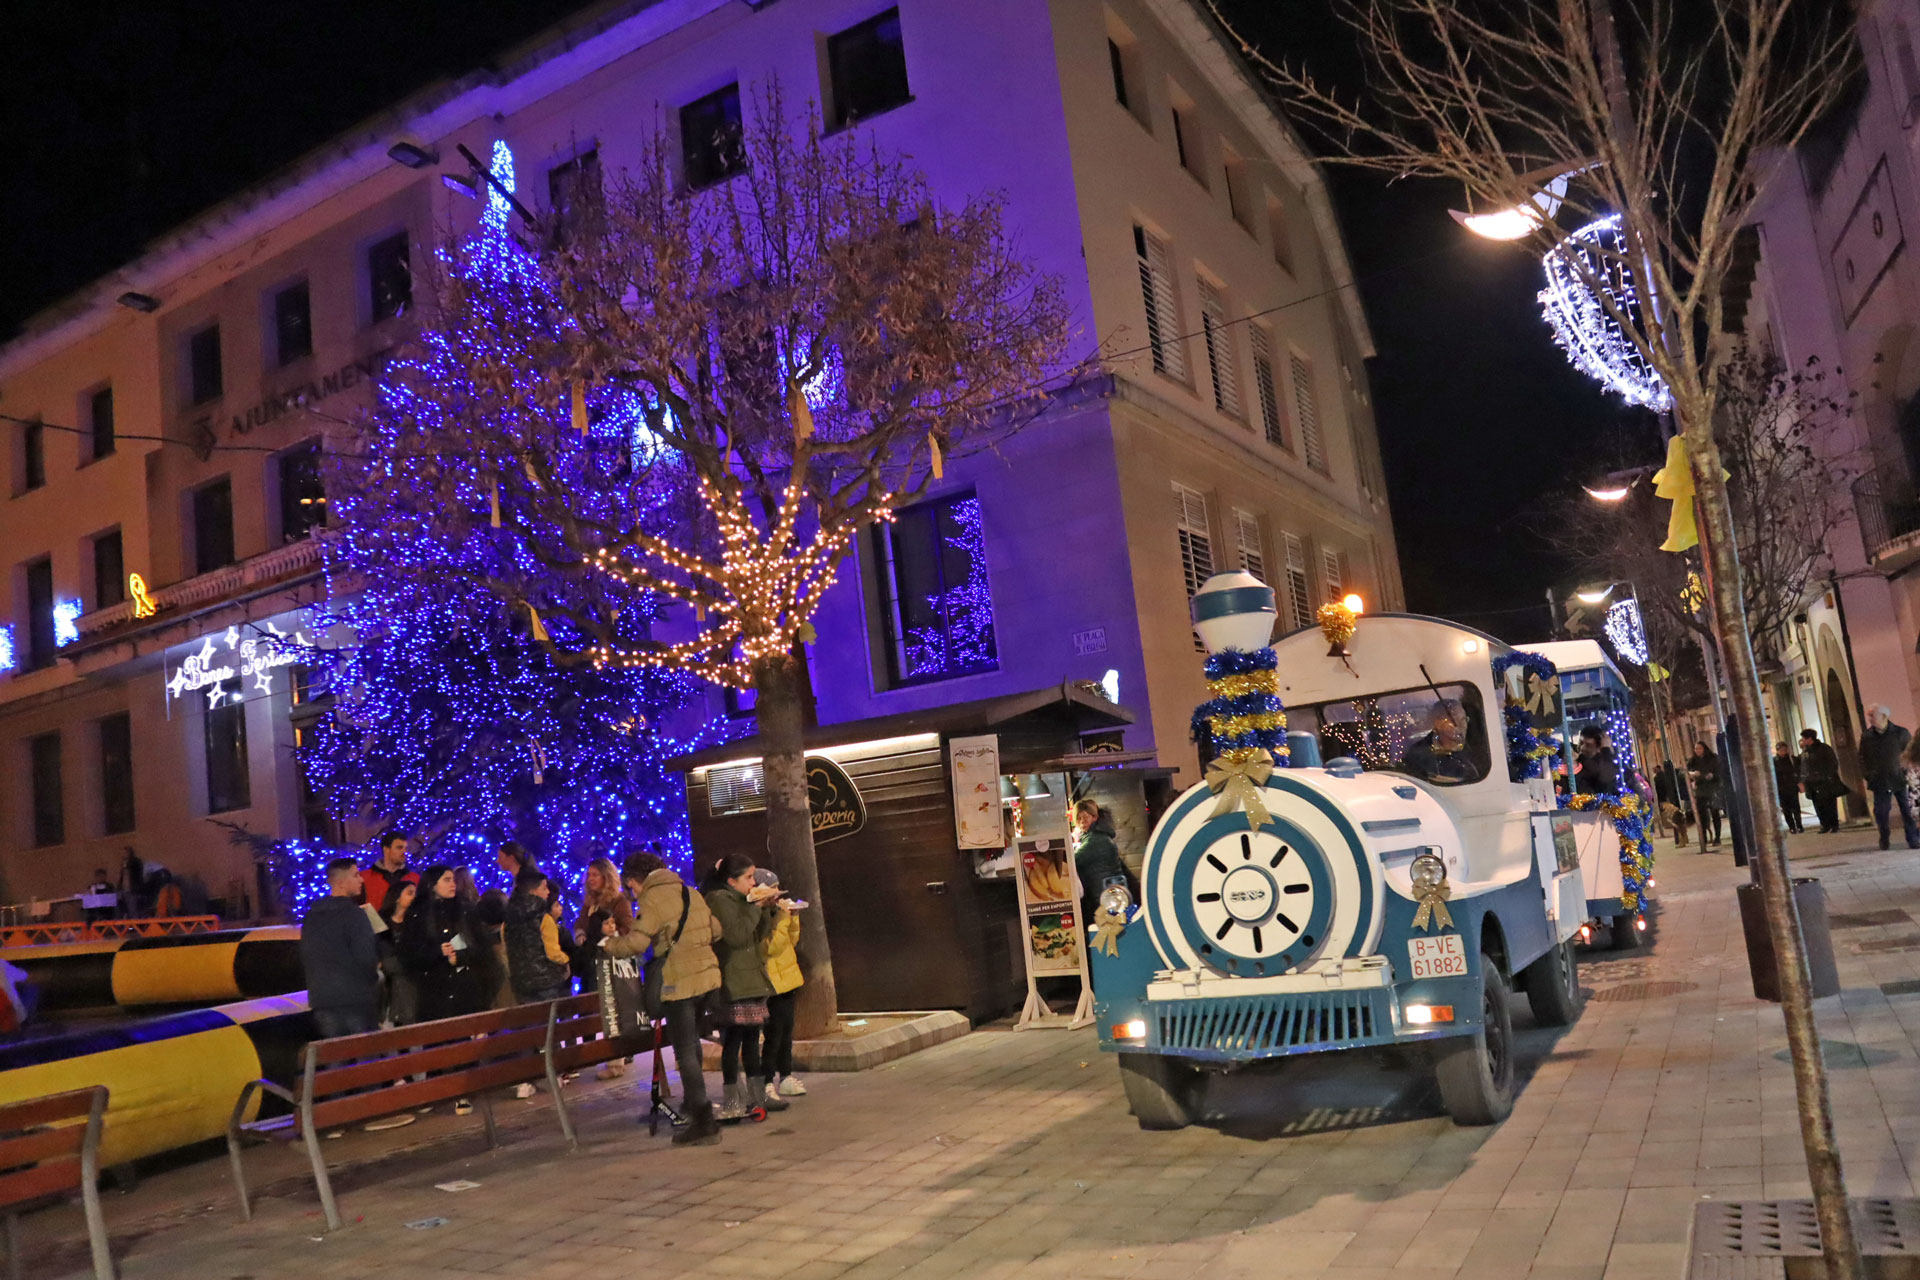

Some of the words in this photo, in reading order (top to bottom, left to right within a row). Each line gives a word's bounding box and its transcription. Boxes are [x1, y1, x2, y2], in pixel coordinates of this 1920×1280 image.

[183, 655, 234, 691] Bones
[811, 810, 856, 831] reperia
[1415, 937, 1456, 957] B-VE
[1414, 956, 1464, 976] 61882
